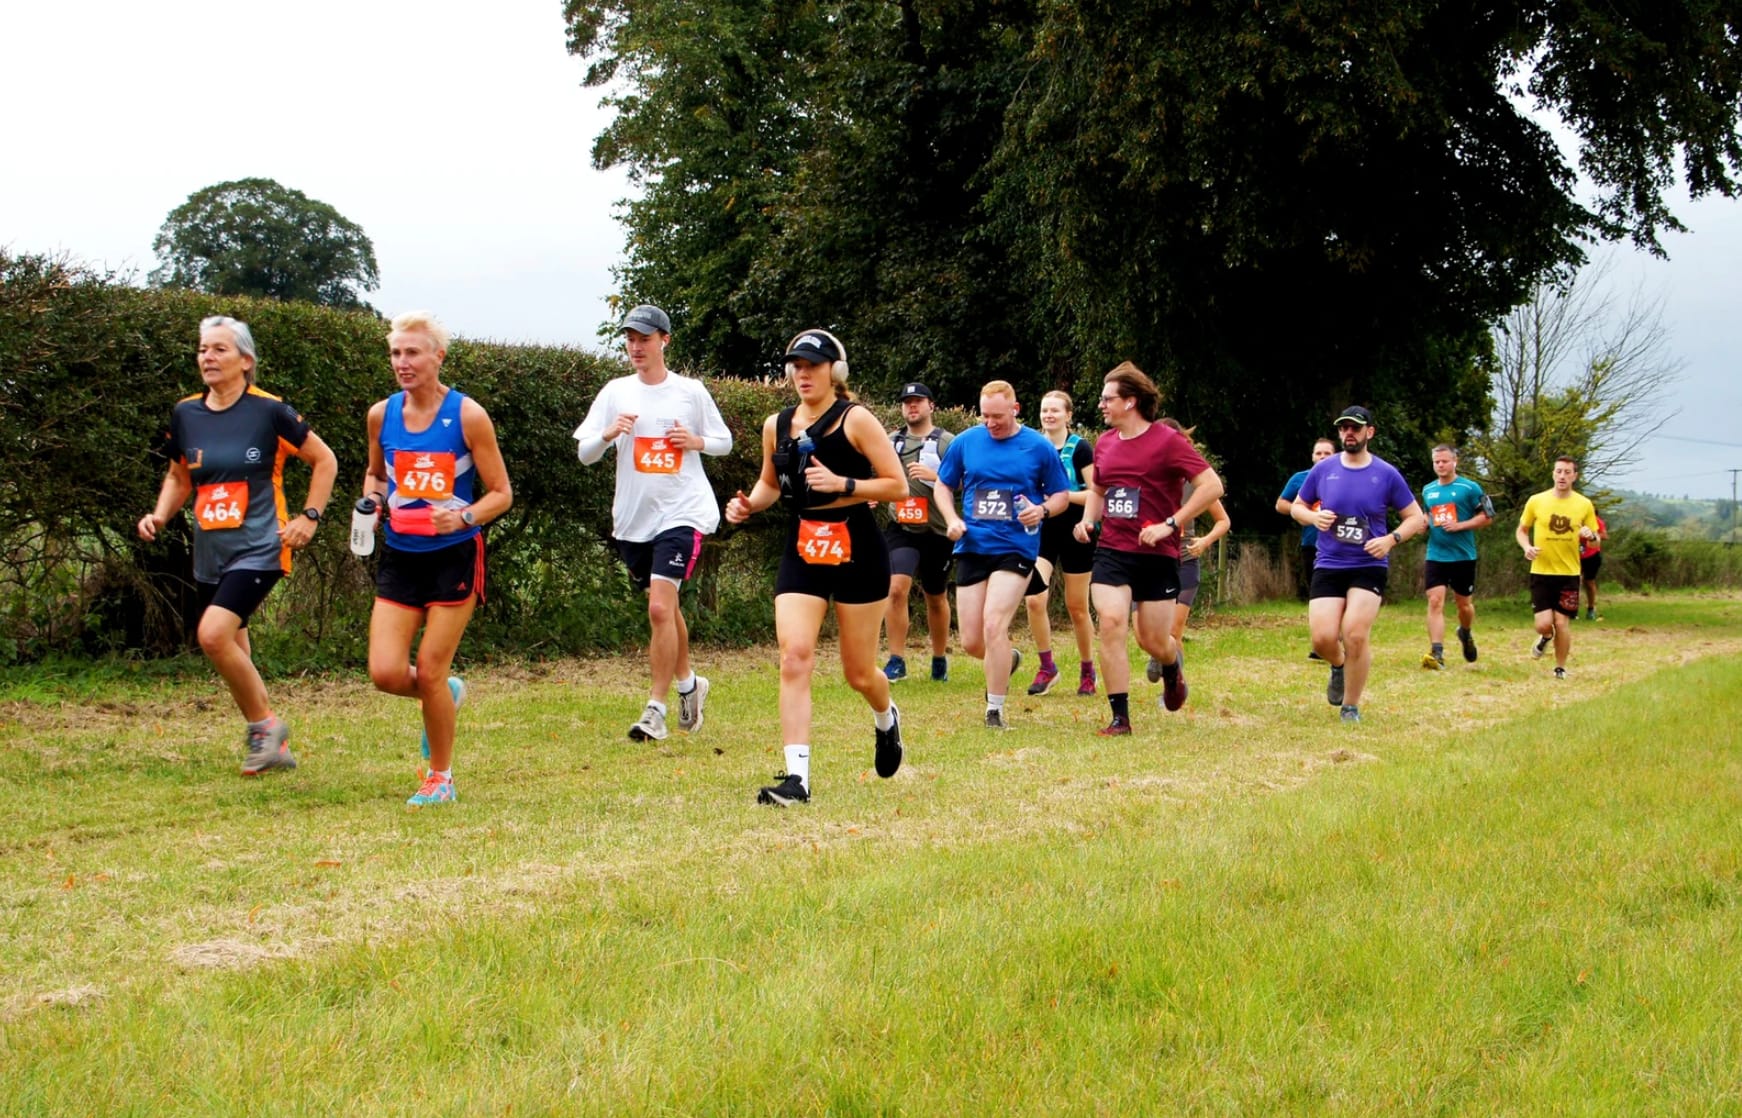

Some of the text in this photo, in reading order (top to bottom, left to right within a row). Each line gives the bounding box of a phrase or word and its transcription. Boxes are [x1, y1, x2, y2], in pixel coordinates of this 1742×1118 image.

[640, 452, 675, 468] 445
[403, 470, 446, 492] 476
[202, 501, 241, 522] 464
[898, 508, 923, 520] 459
[978, 500, 1007, 516] 572
[1108, 499, 1133, 514] 566
[1336, 525, 1363, 541] 573
[804, 539, 844, 558] 474
